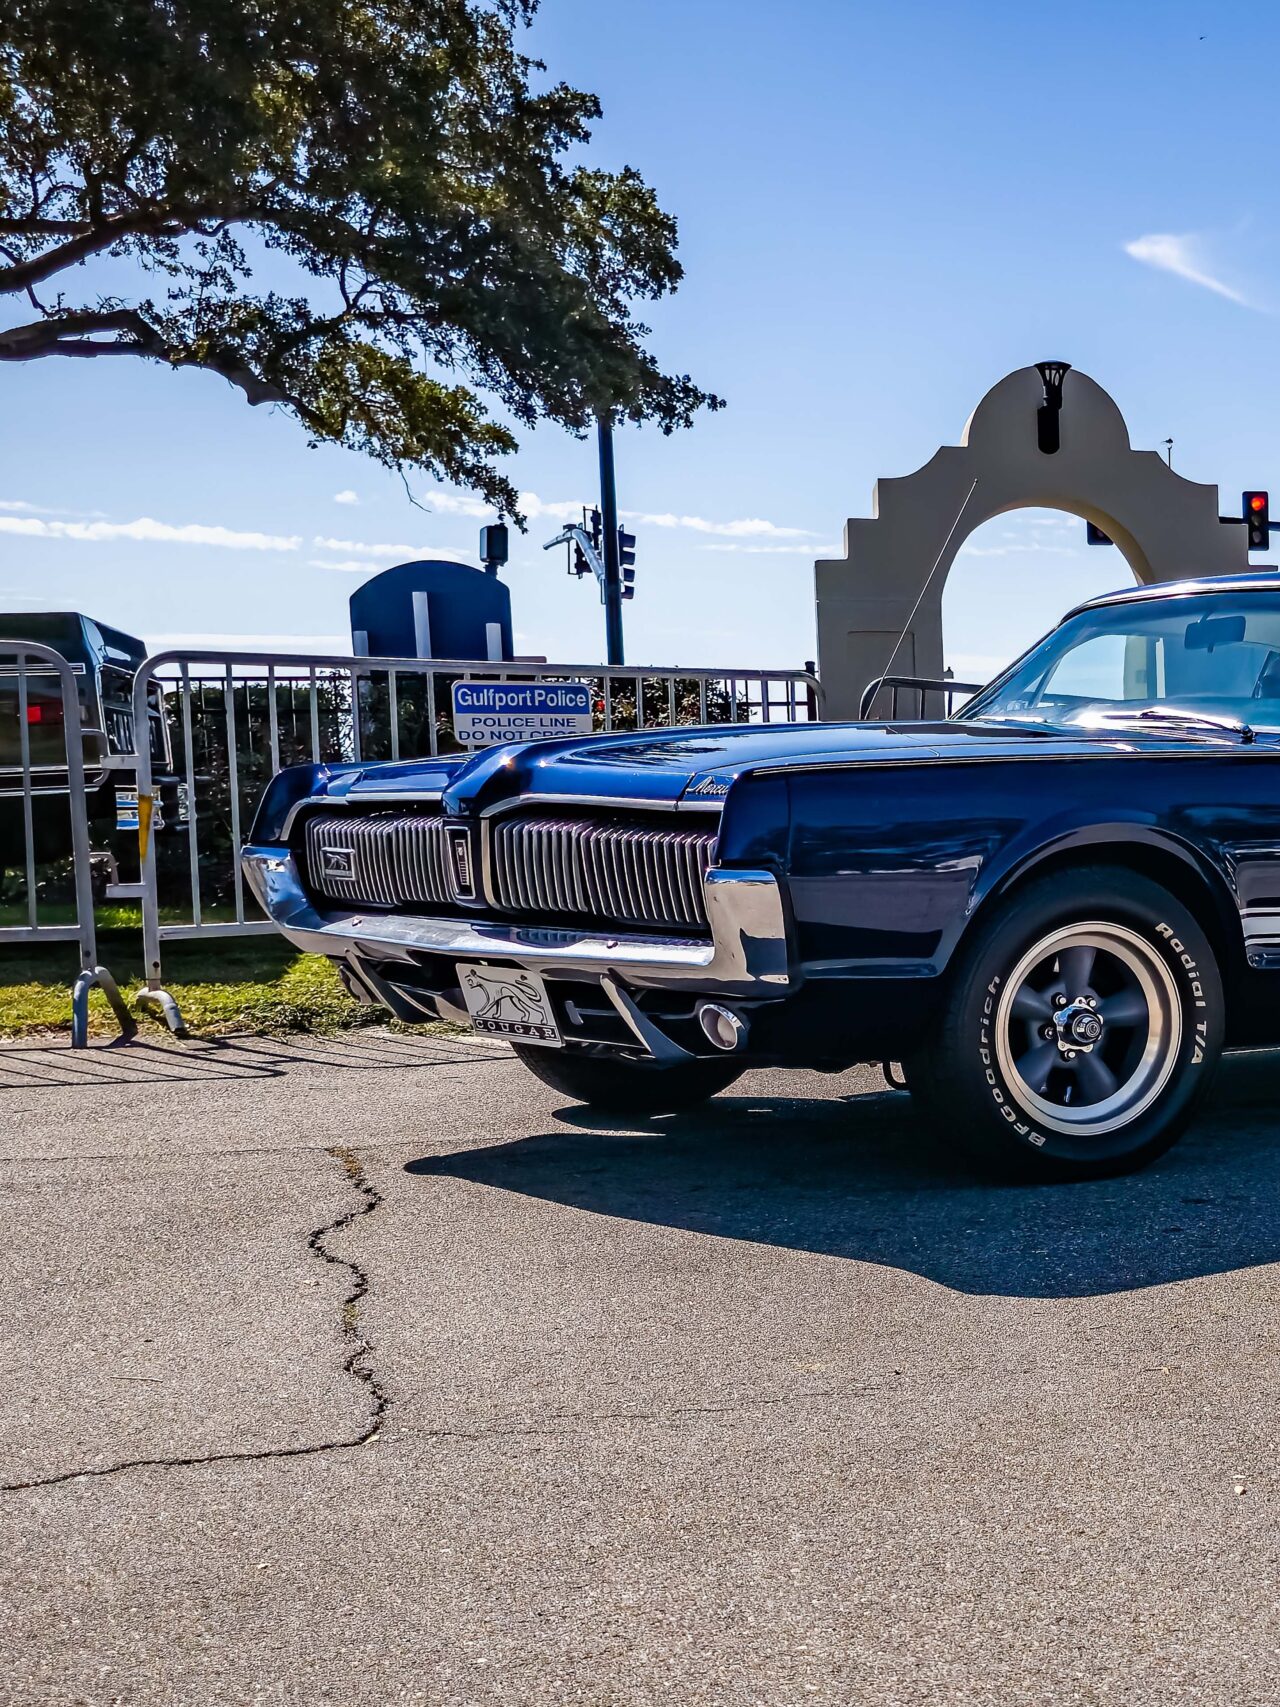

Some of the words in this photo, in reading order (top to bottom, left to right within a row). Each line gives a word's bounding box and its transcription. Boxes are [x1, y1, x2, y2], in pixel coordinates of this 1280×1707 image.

[457, 688, 532, 711] Gulfport
[534, 689, 587, 707] Police
[471, 717, 536, 727] POLICE
[539, 717, 577, 727] LINE
[458, 730, 487, 741] DO
[490, 730, 527, 741] NOT
[1154, 922, 1206, 1007] Radial
[1190, 1020, 1207, 1064] T/A
[475, 1019, 555, 1038] COUGAR
[978, 975, 1047, 1147] BFGoodrich
